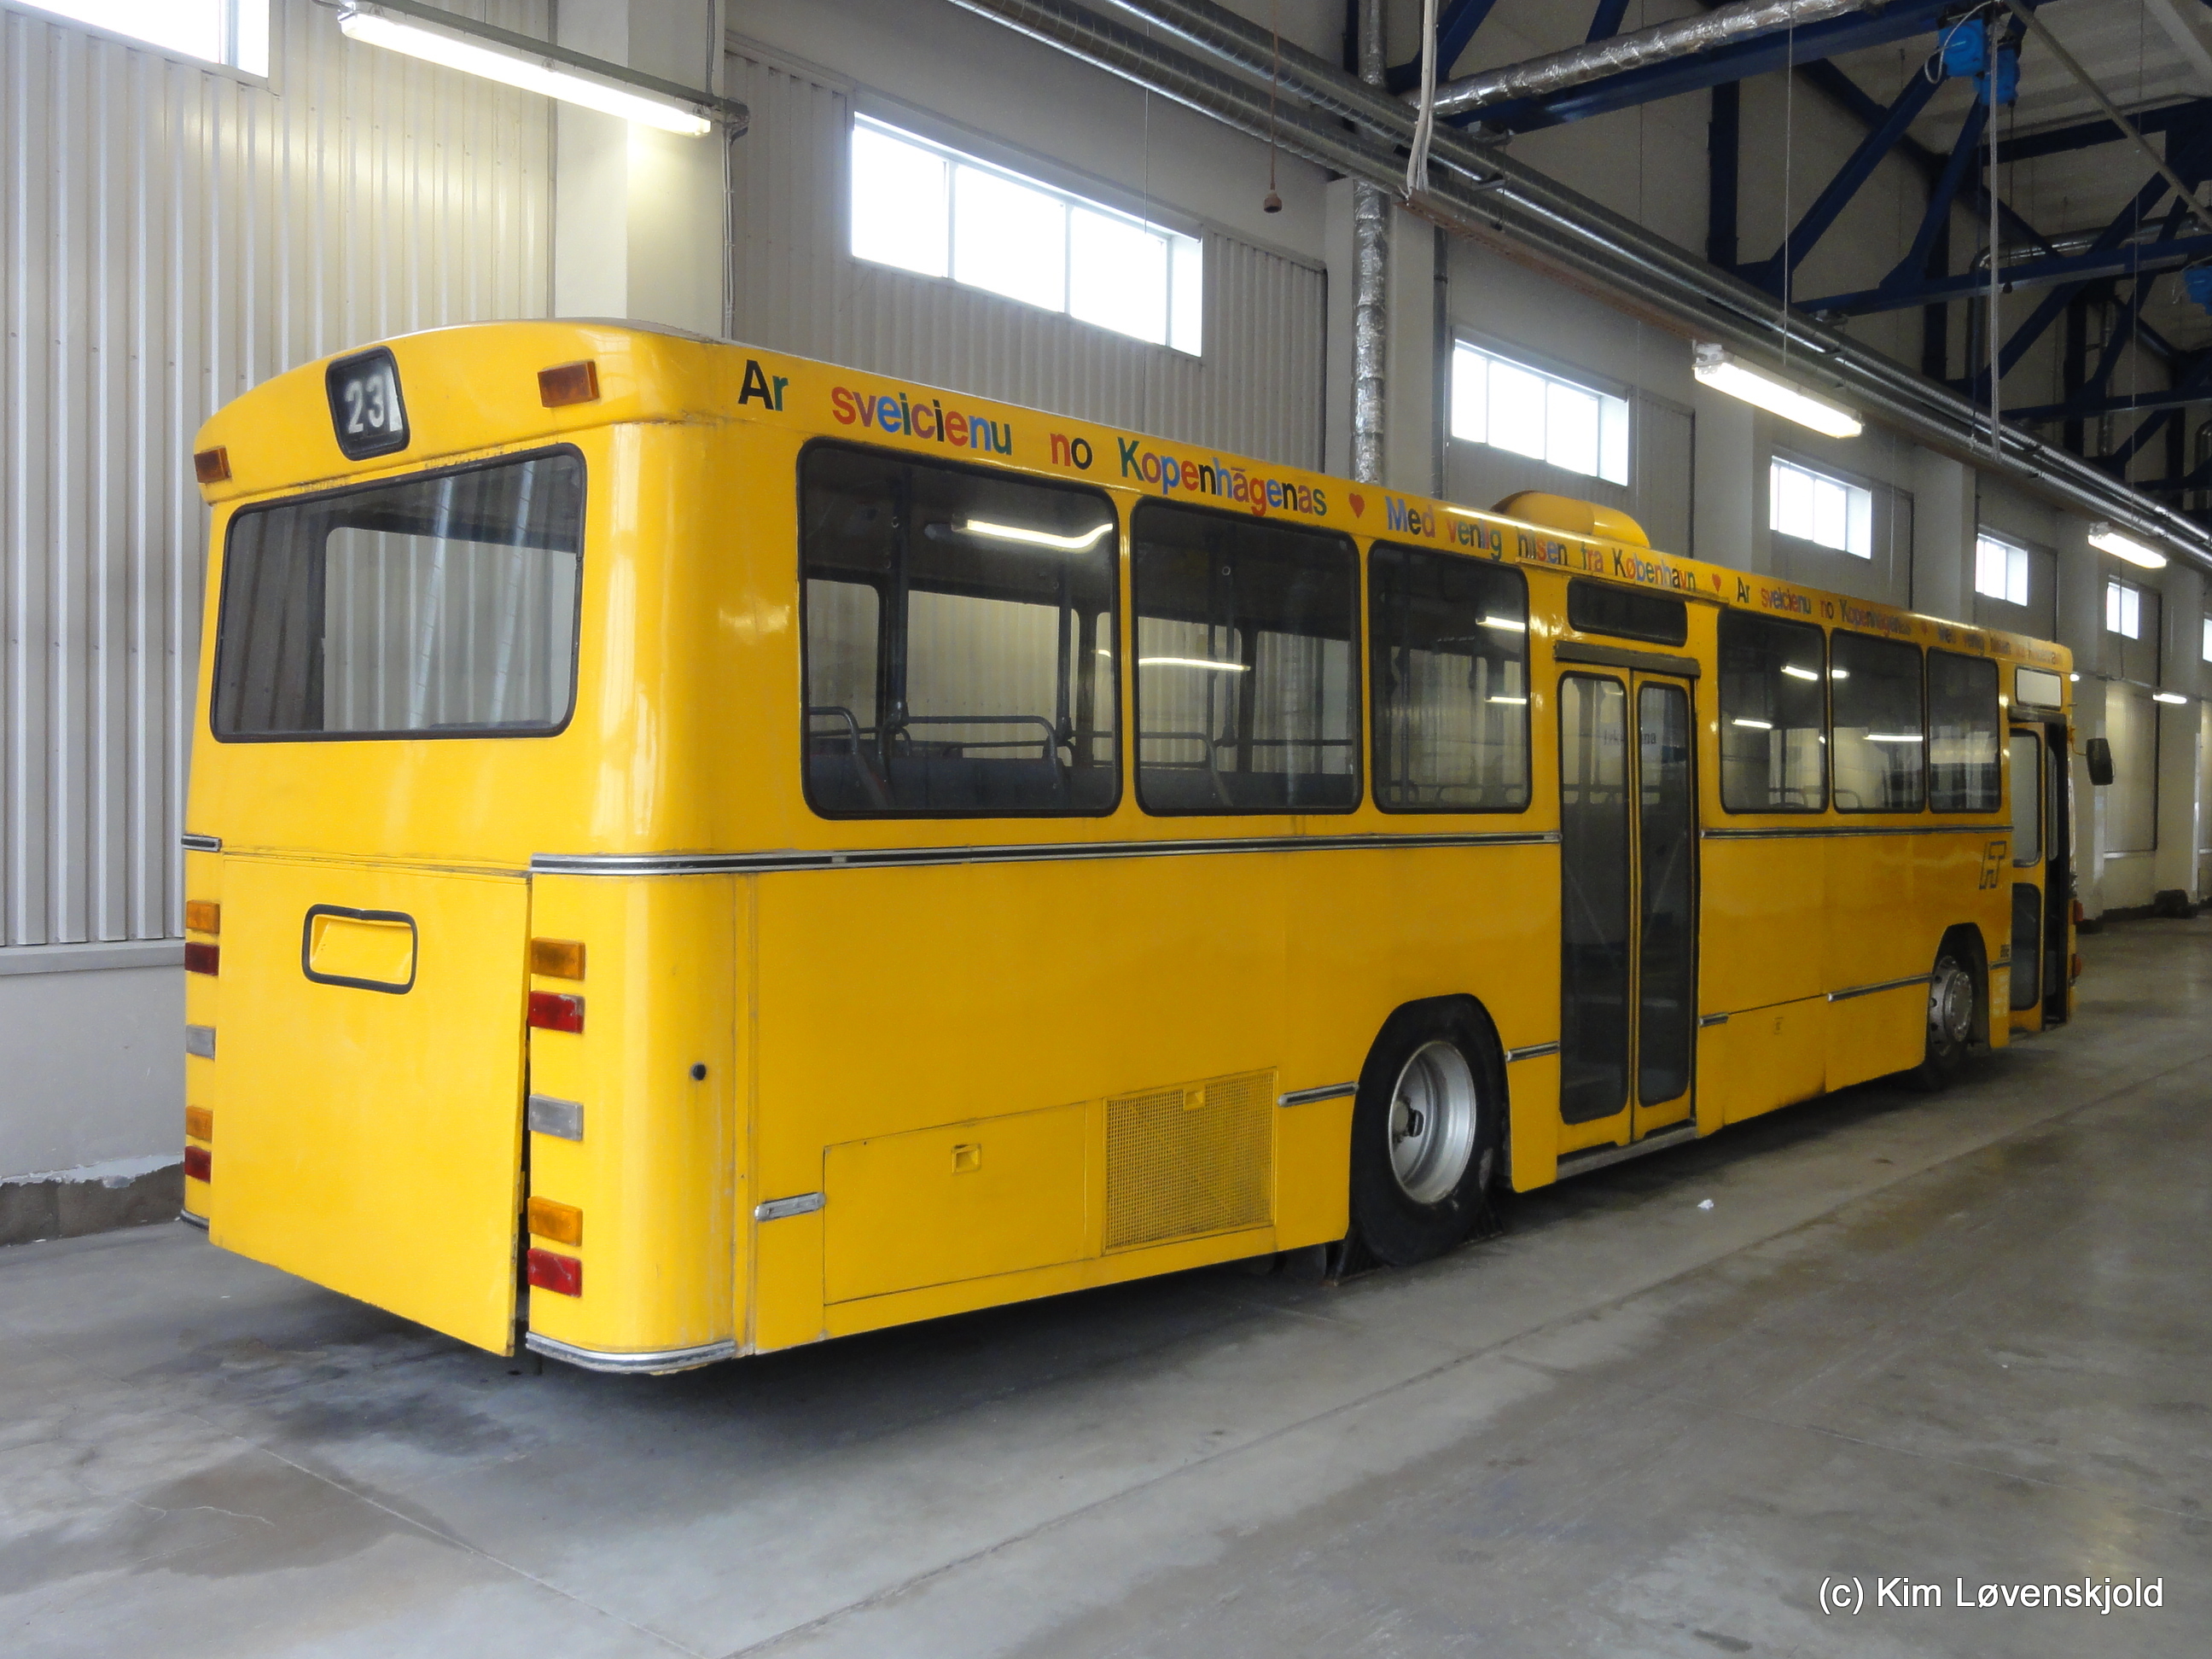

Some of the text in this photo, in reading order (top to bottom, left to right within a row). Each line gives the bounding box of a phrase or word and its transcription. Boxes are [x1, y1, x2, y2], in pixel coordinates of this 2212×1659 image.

[344, 373, 385, 434] 23
[738, 358, 1328, 517] Ar sveicienu no Kopenhāgenas
[1384, 495, 1436, 538] Med
[1443, 517, 1503, 561] venlig
[1580, 540, 1604, 573] fra
[1610, 547, 1697, 593] København
[1737, 576, 1750, 603] Ar
[1819, 599, 1835, 620] no
